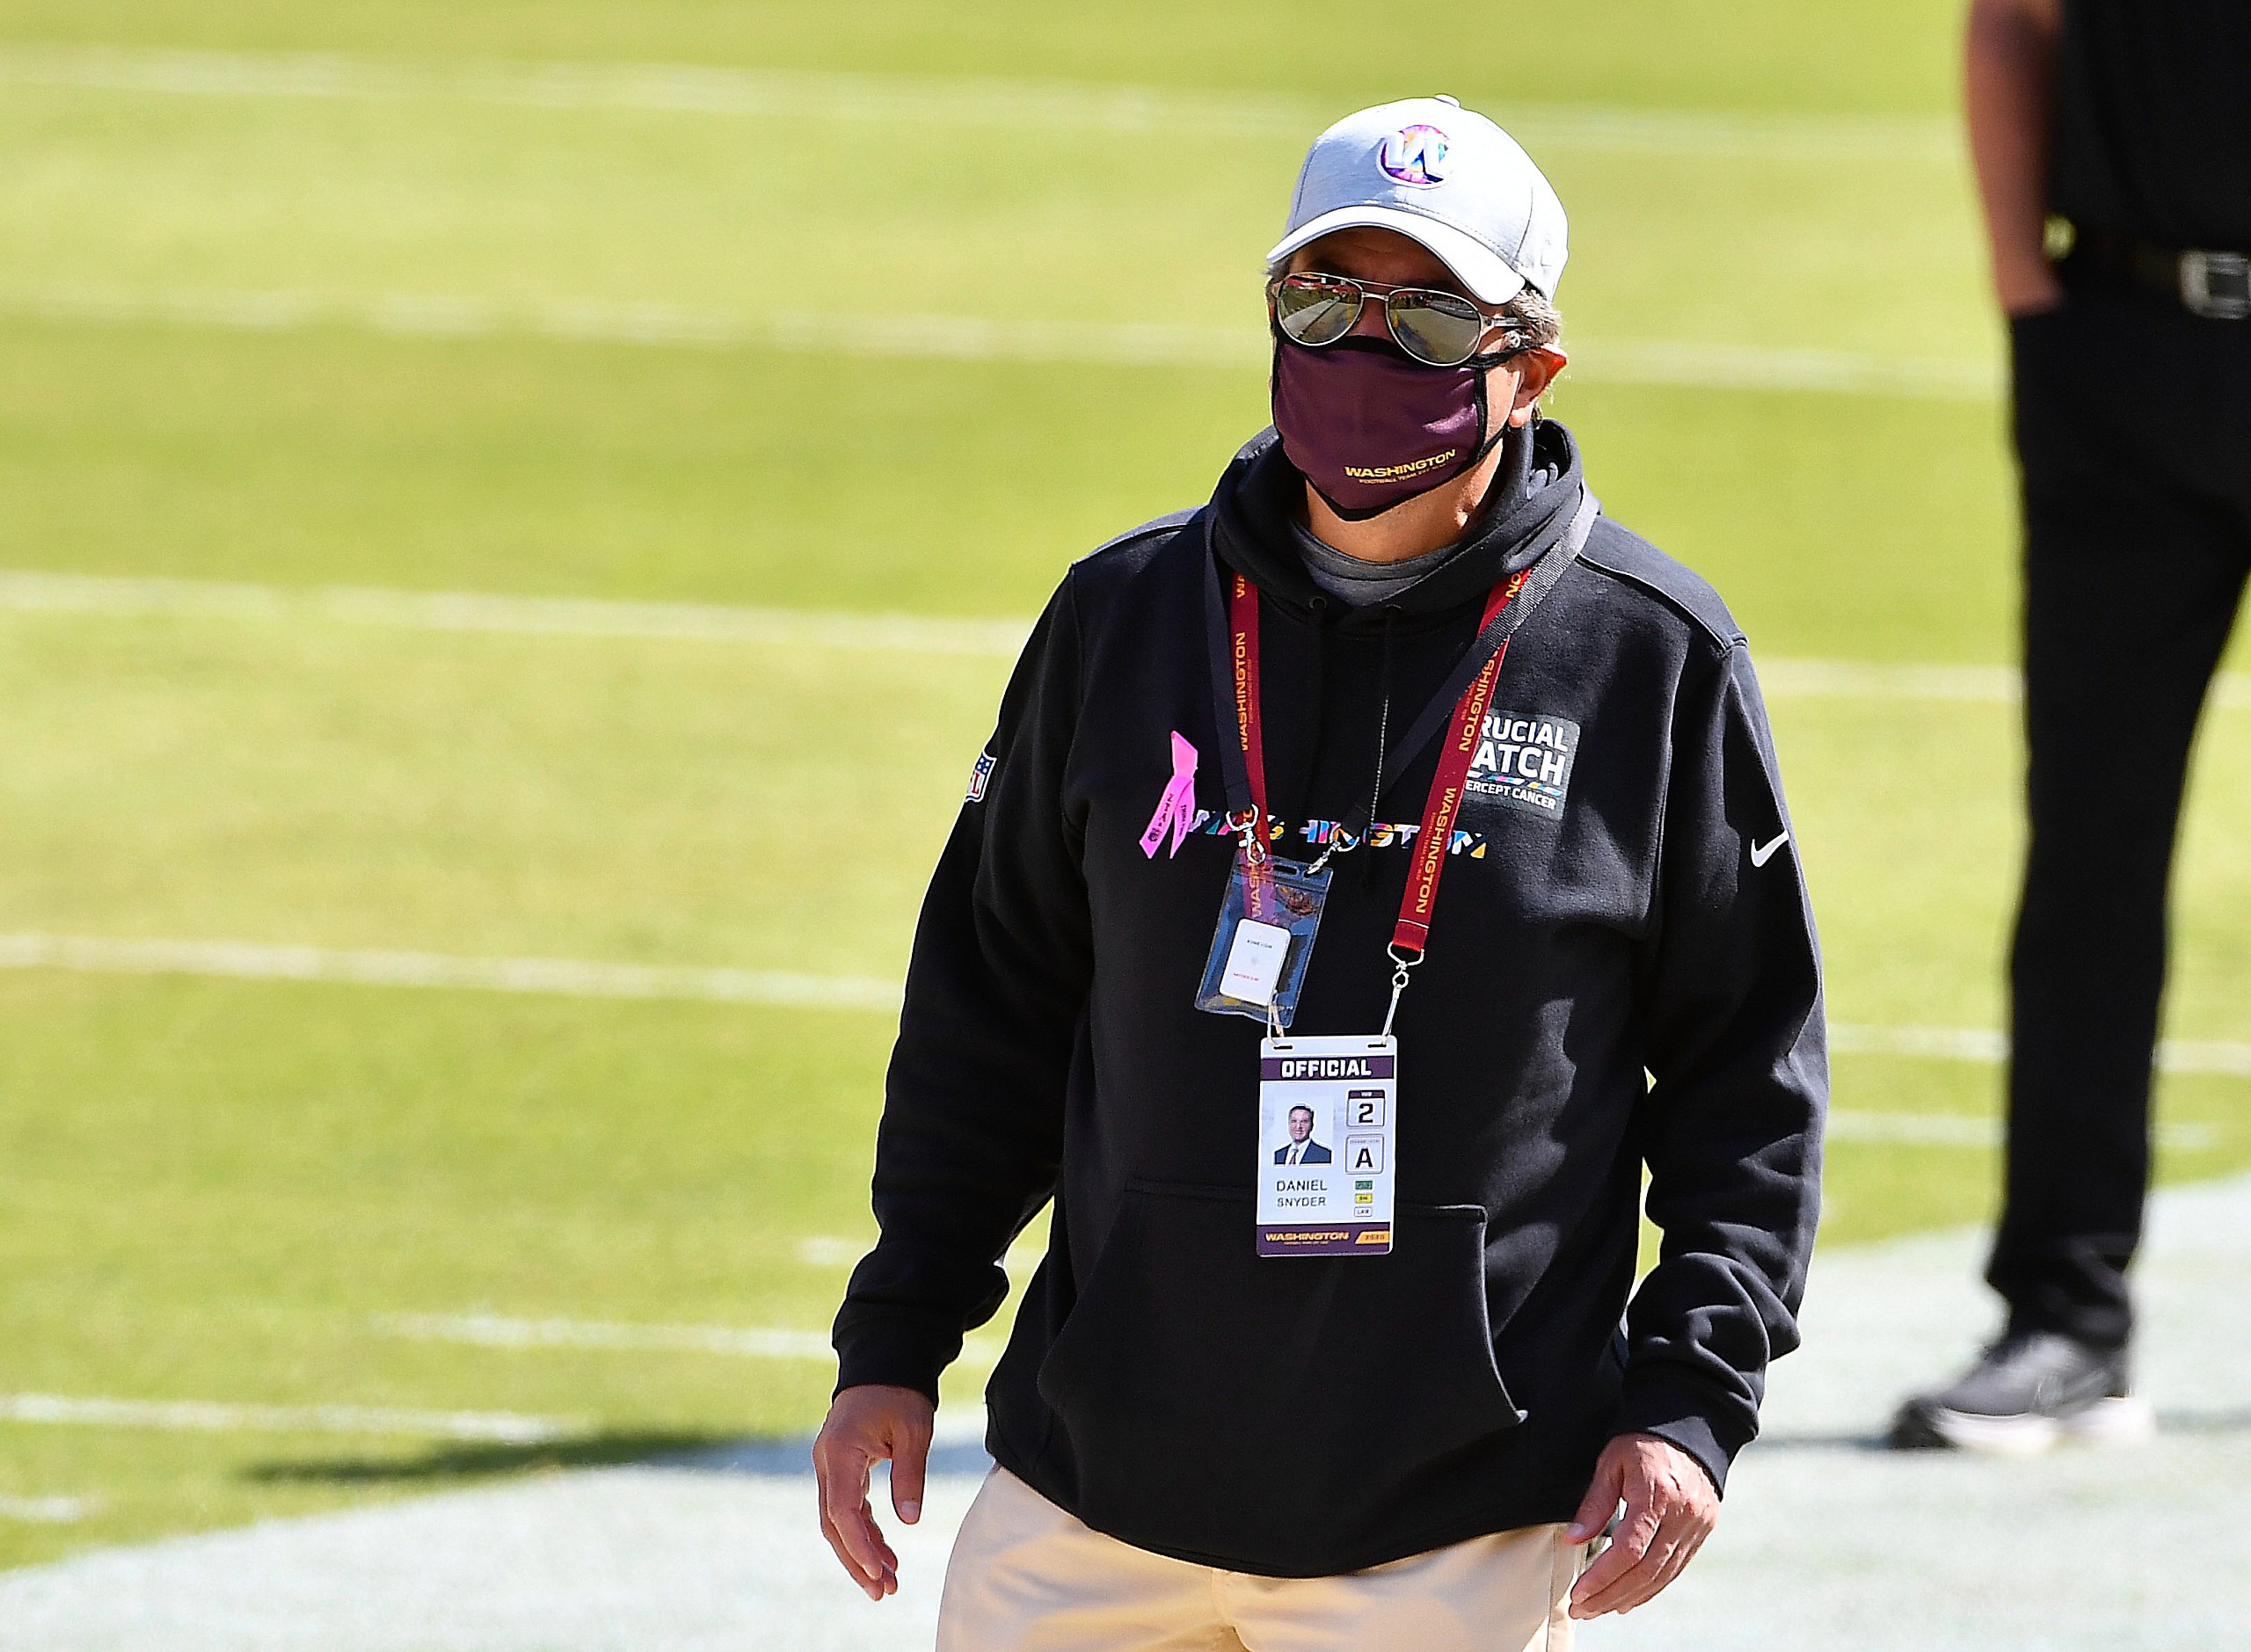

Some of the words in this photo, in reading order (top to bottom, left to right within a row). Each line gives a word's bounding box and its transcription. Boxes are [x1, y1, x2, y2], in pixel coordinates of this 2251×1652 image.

[1344, 448, 1456, 478] WASHINGTON
[1235, 632, 1249, 751] WASHINGTON
[1458, 651, 1497, 752] SHINGTON
[1482, 715, 1568, 752] RUCIAL
[1470, 740, 1566, 786] ATCH
[1465, 780, 1512, 797] ERCEPT
[1512, 788, 1556, 810] CANCER
[1416, 788, 1457, 914] WASHINGTON
[1281, 1059, 1373, 1078] OFFICIAL
[1359, 1103, 1373, 1124] 2
[1355, 1148, 1373, 1168] A
[1276, 1180, 1328, 1192] DANIEL
[1277, 1197, 1326, 1208] SNYDER
[1265, 1232, 1350, 1242] WASHINGTON
